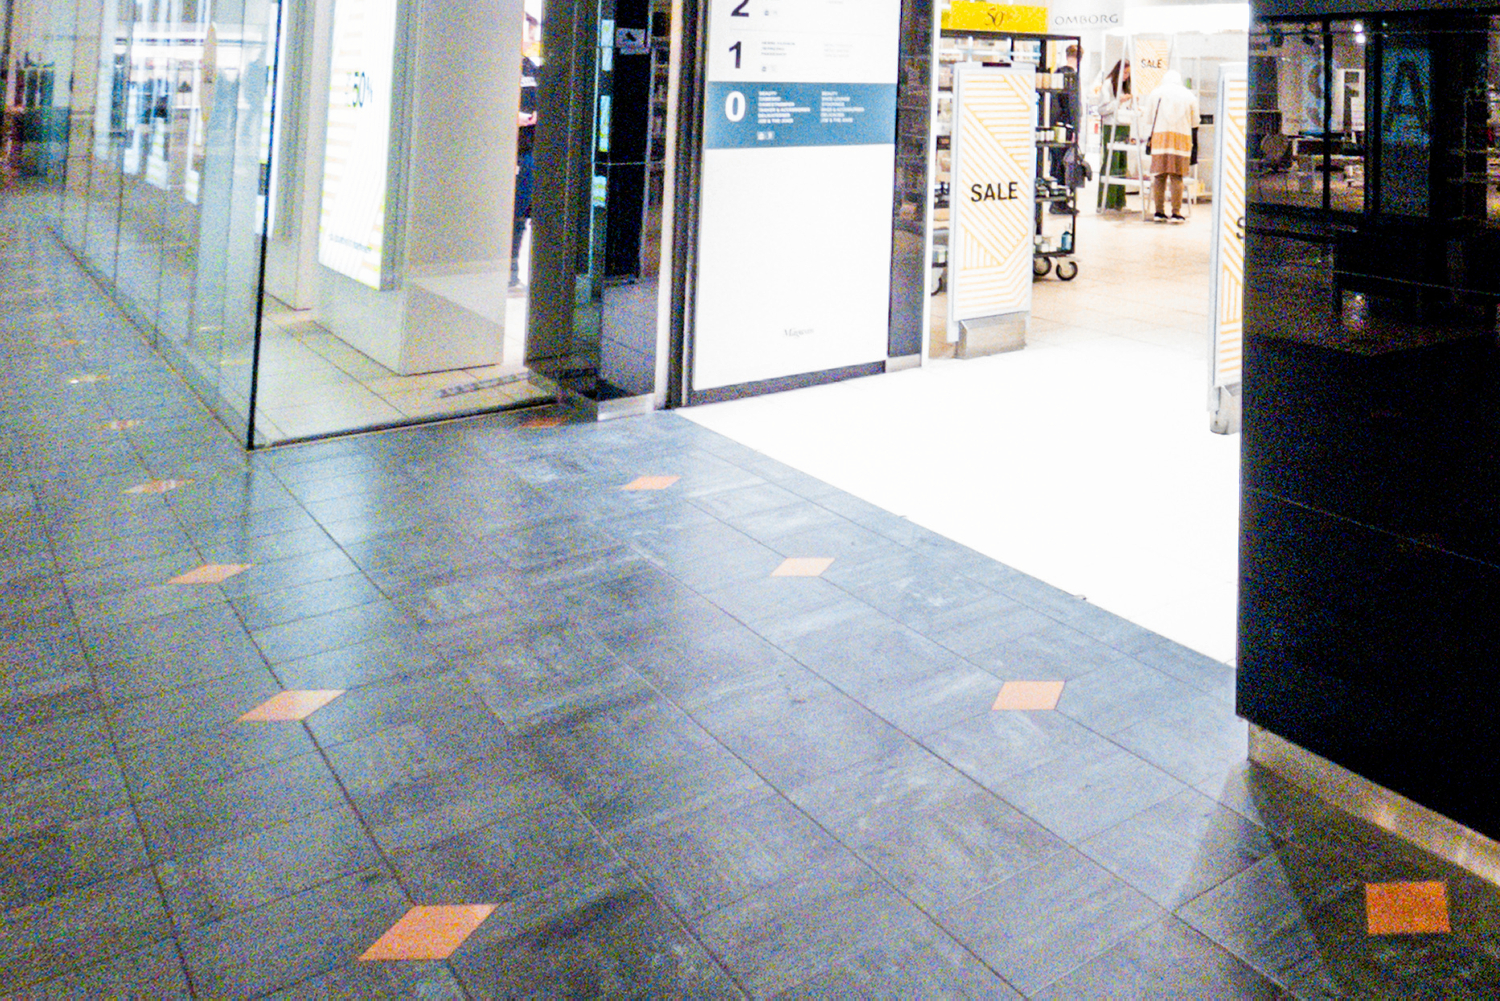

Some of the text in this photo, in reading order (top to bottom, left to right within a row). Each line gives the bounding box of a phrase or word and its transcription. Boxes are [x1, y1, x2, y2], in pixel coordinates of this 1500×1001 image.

[728, 40, 742, 69] 1
[1140, 57, 1163, 69] SALE
[724, 90, 746, 122] 0
[970, 181, 1018, 203] SALE
